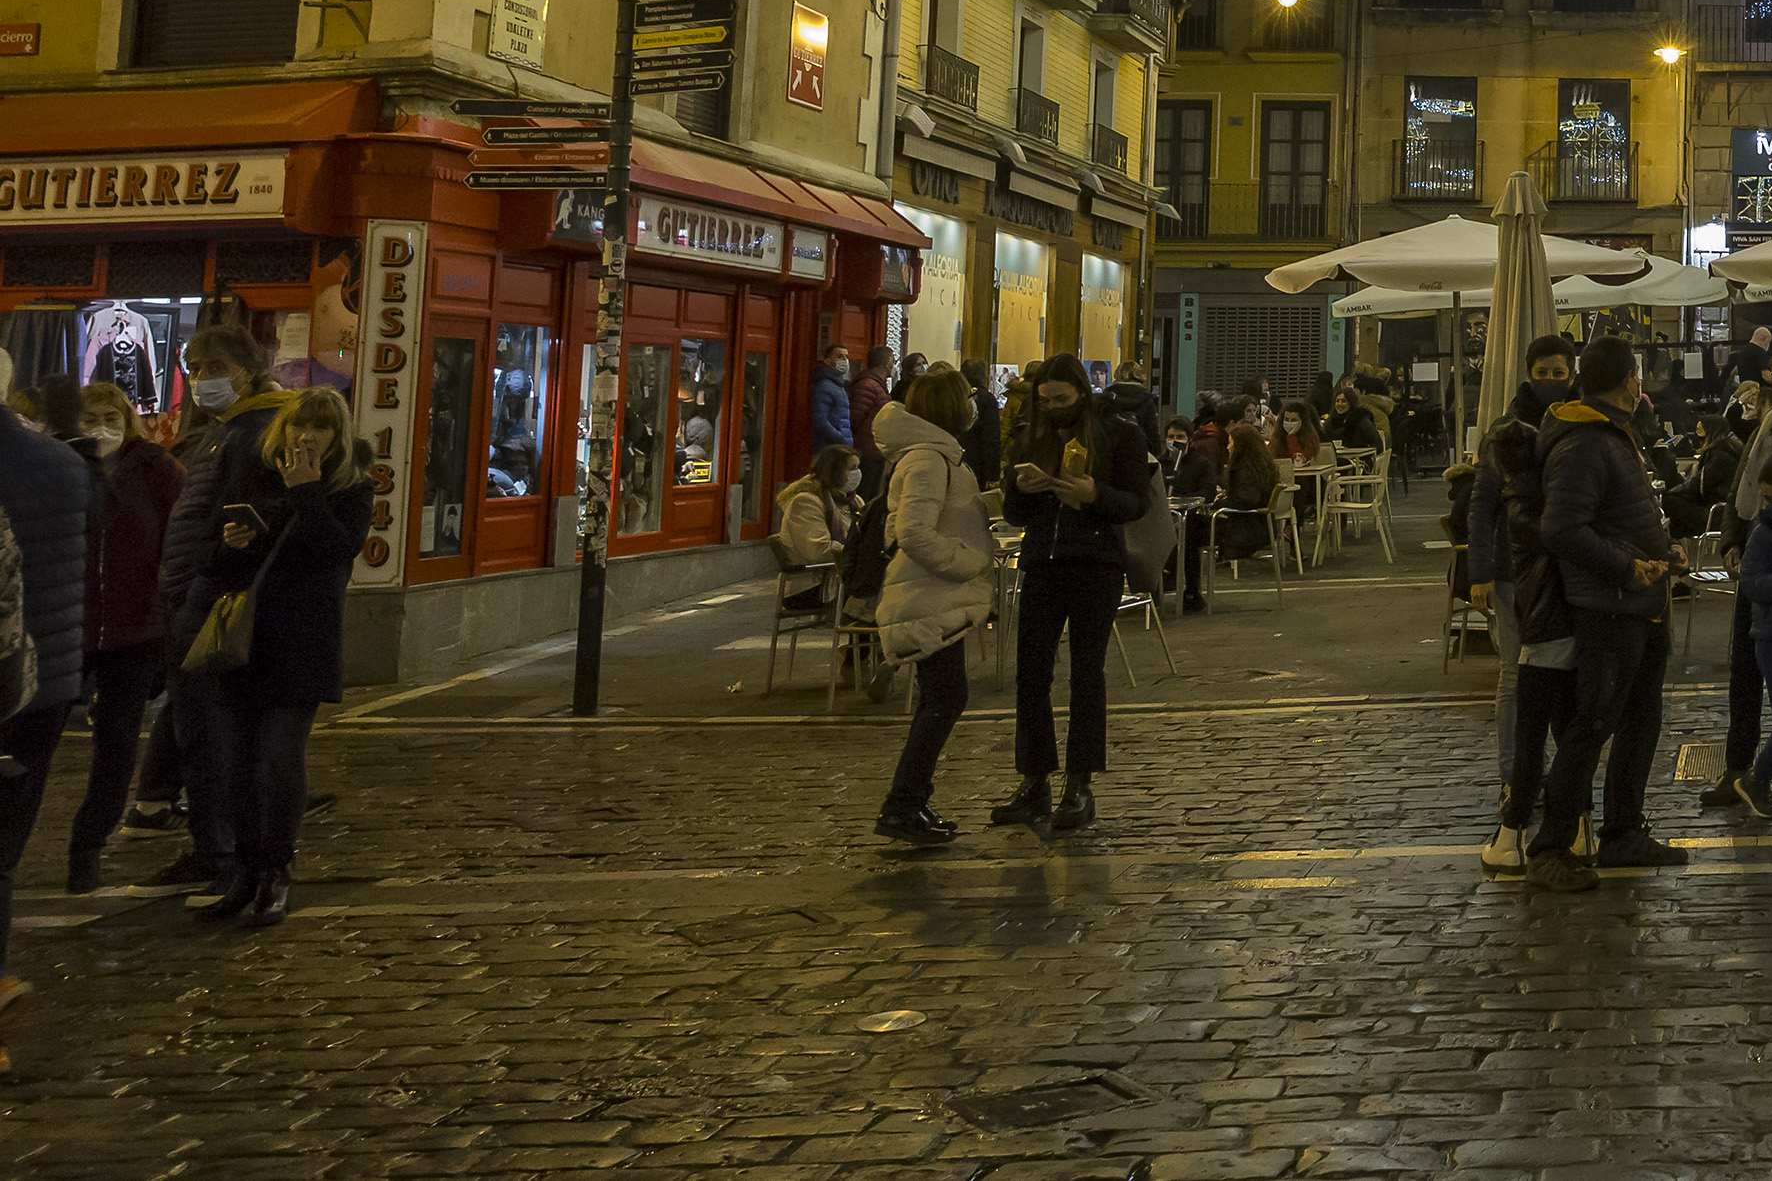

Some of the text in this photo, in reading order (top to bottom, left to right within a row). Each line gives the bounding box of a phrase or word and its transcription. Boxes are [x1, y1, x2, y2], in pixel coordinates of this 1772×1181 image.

[510, 38, 528, 55] PLAZA
[0, 162, 241, 210] GUTIERREZ
[249, 184, 273, 195] 1840
[656, 206, 766, 259] GUTIERREZ
[1345, 304, 1372, 313] AMBAR
[1555, 298, 1570, 306] BAR
[372, 236, 414, 410] DESDE
